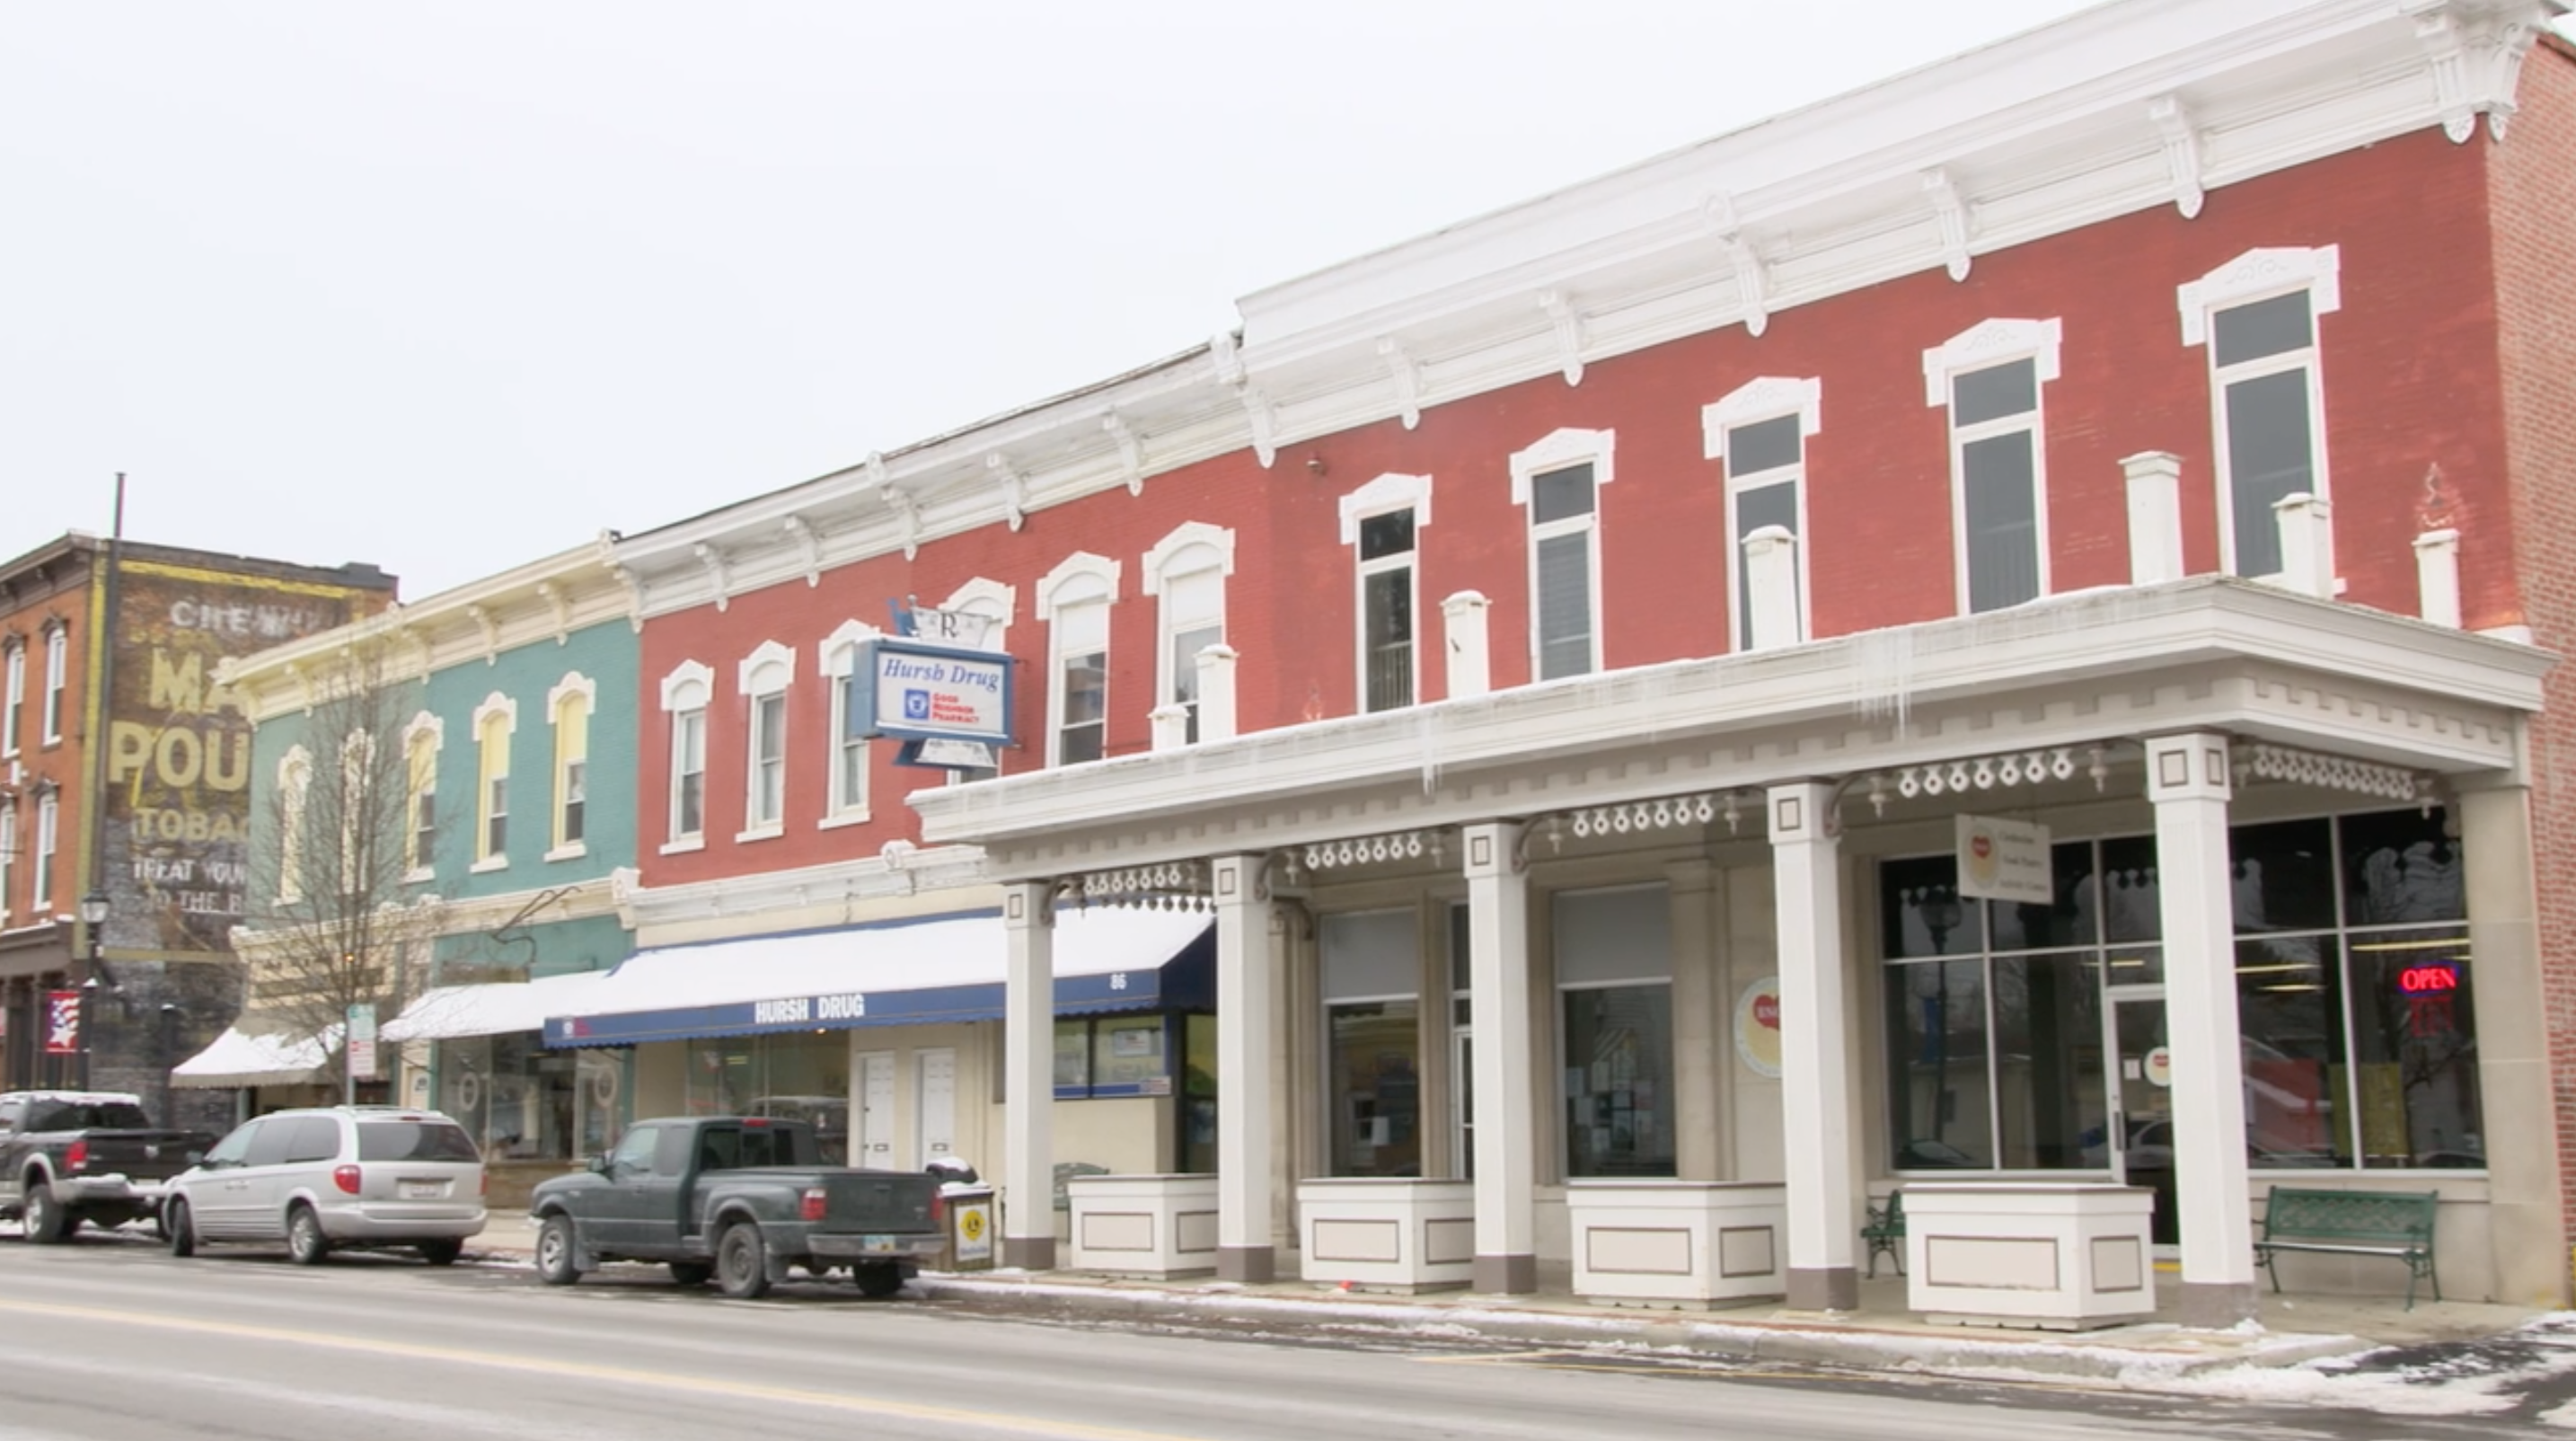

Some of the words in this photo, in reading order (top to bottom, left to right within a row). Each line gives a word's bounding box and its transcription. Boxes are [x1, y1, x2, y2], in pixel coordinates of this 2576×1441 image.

[883, 658, 944, 683] Hursh
[949, 665, 1000, 693] Drug
[108, 720, 250, 791] POU
[133, 859, 196, 881] TREAT
[178, 889, 222, 913] THE
[2401, 967, 2457, 992] OPEN
[755, 998, 808, 1024] HURSH
[817, 993, 865, 1019] DRUG
